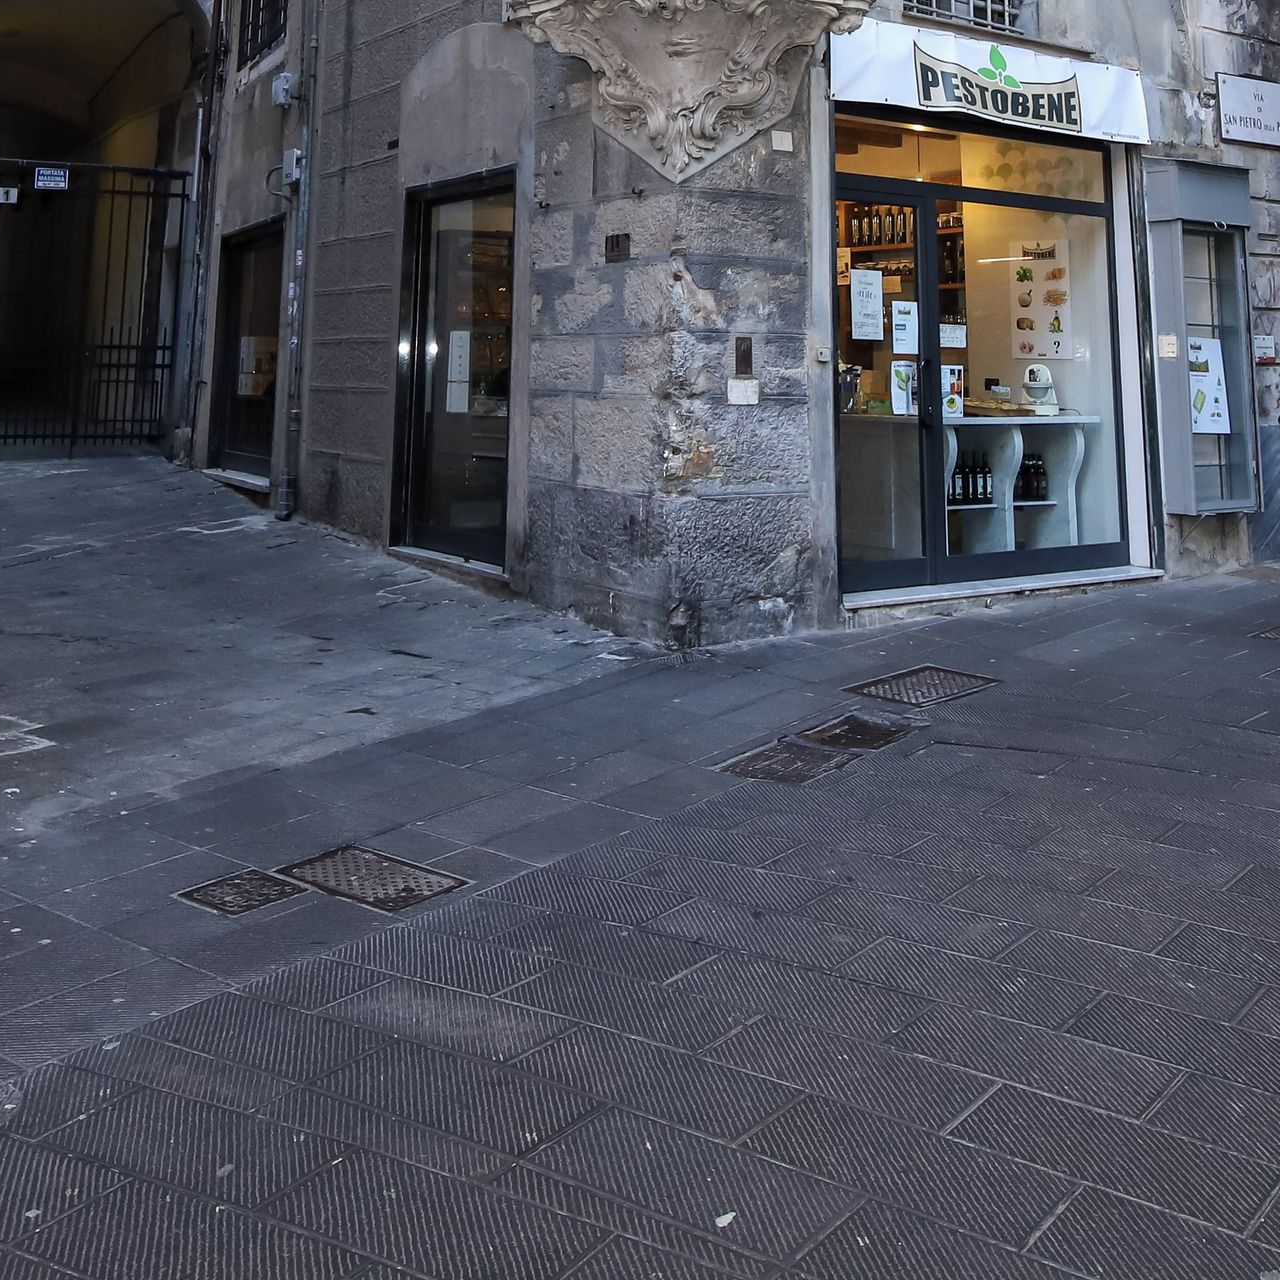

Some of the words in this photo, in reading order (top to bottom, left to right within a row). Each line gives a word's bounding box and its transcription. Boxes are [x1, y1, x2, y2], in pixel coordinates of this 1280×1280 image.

[919, 61, 1079, 126] PESTOBENE
[1253, 92, 1265, 103] VIA
[1224, 114, 1238, 126] SAN
[1239, 116, 1262, 130] PIETRO
[3, 189, 10, 202] 1
